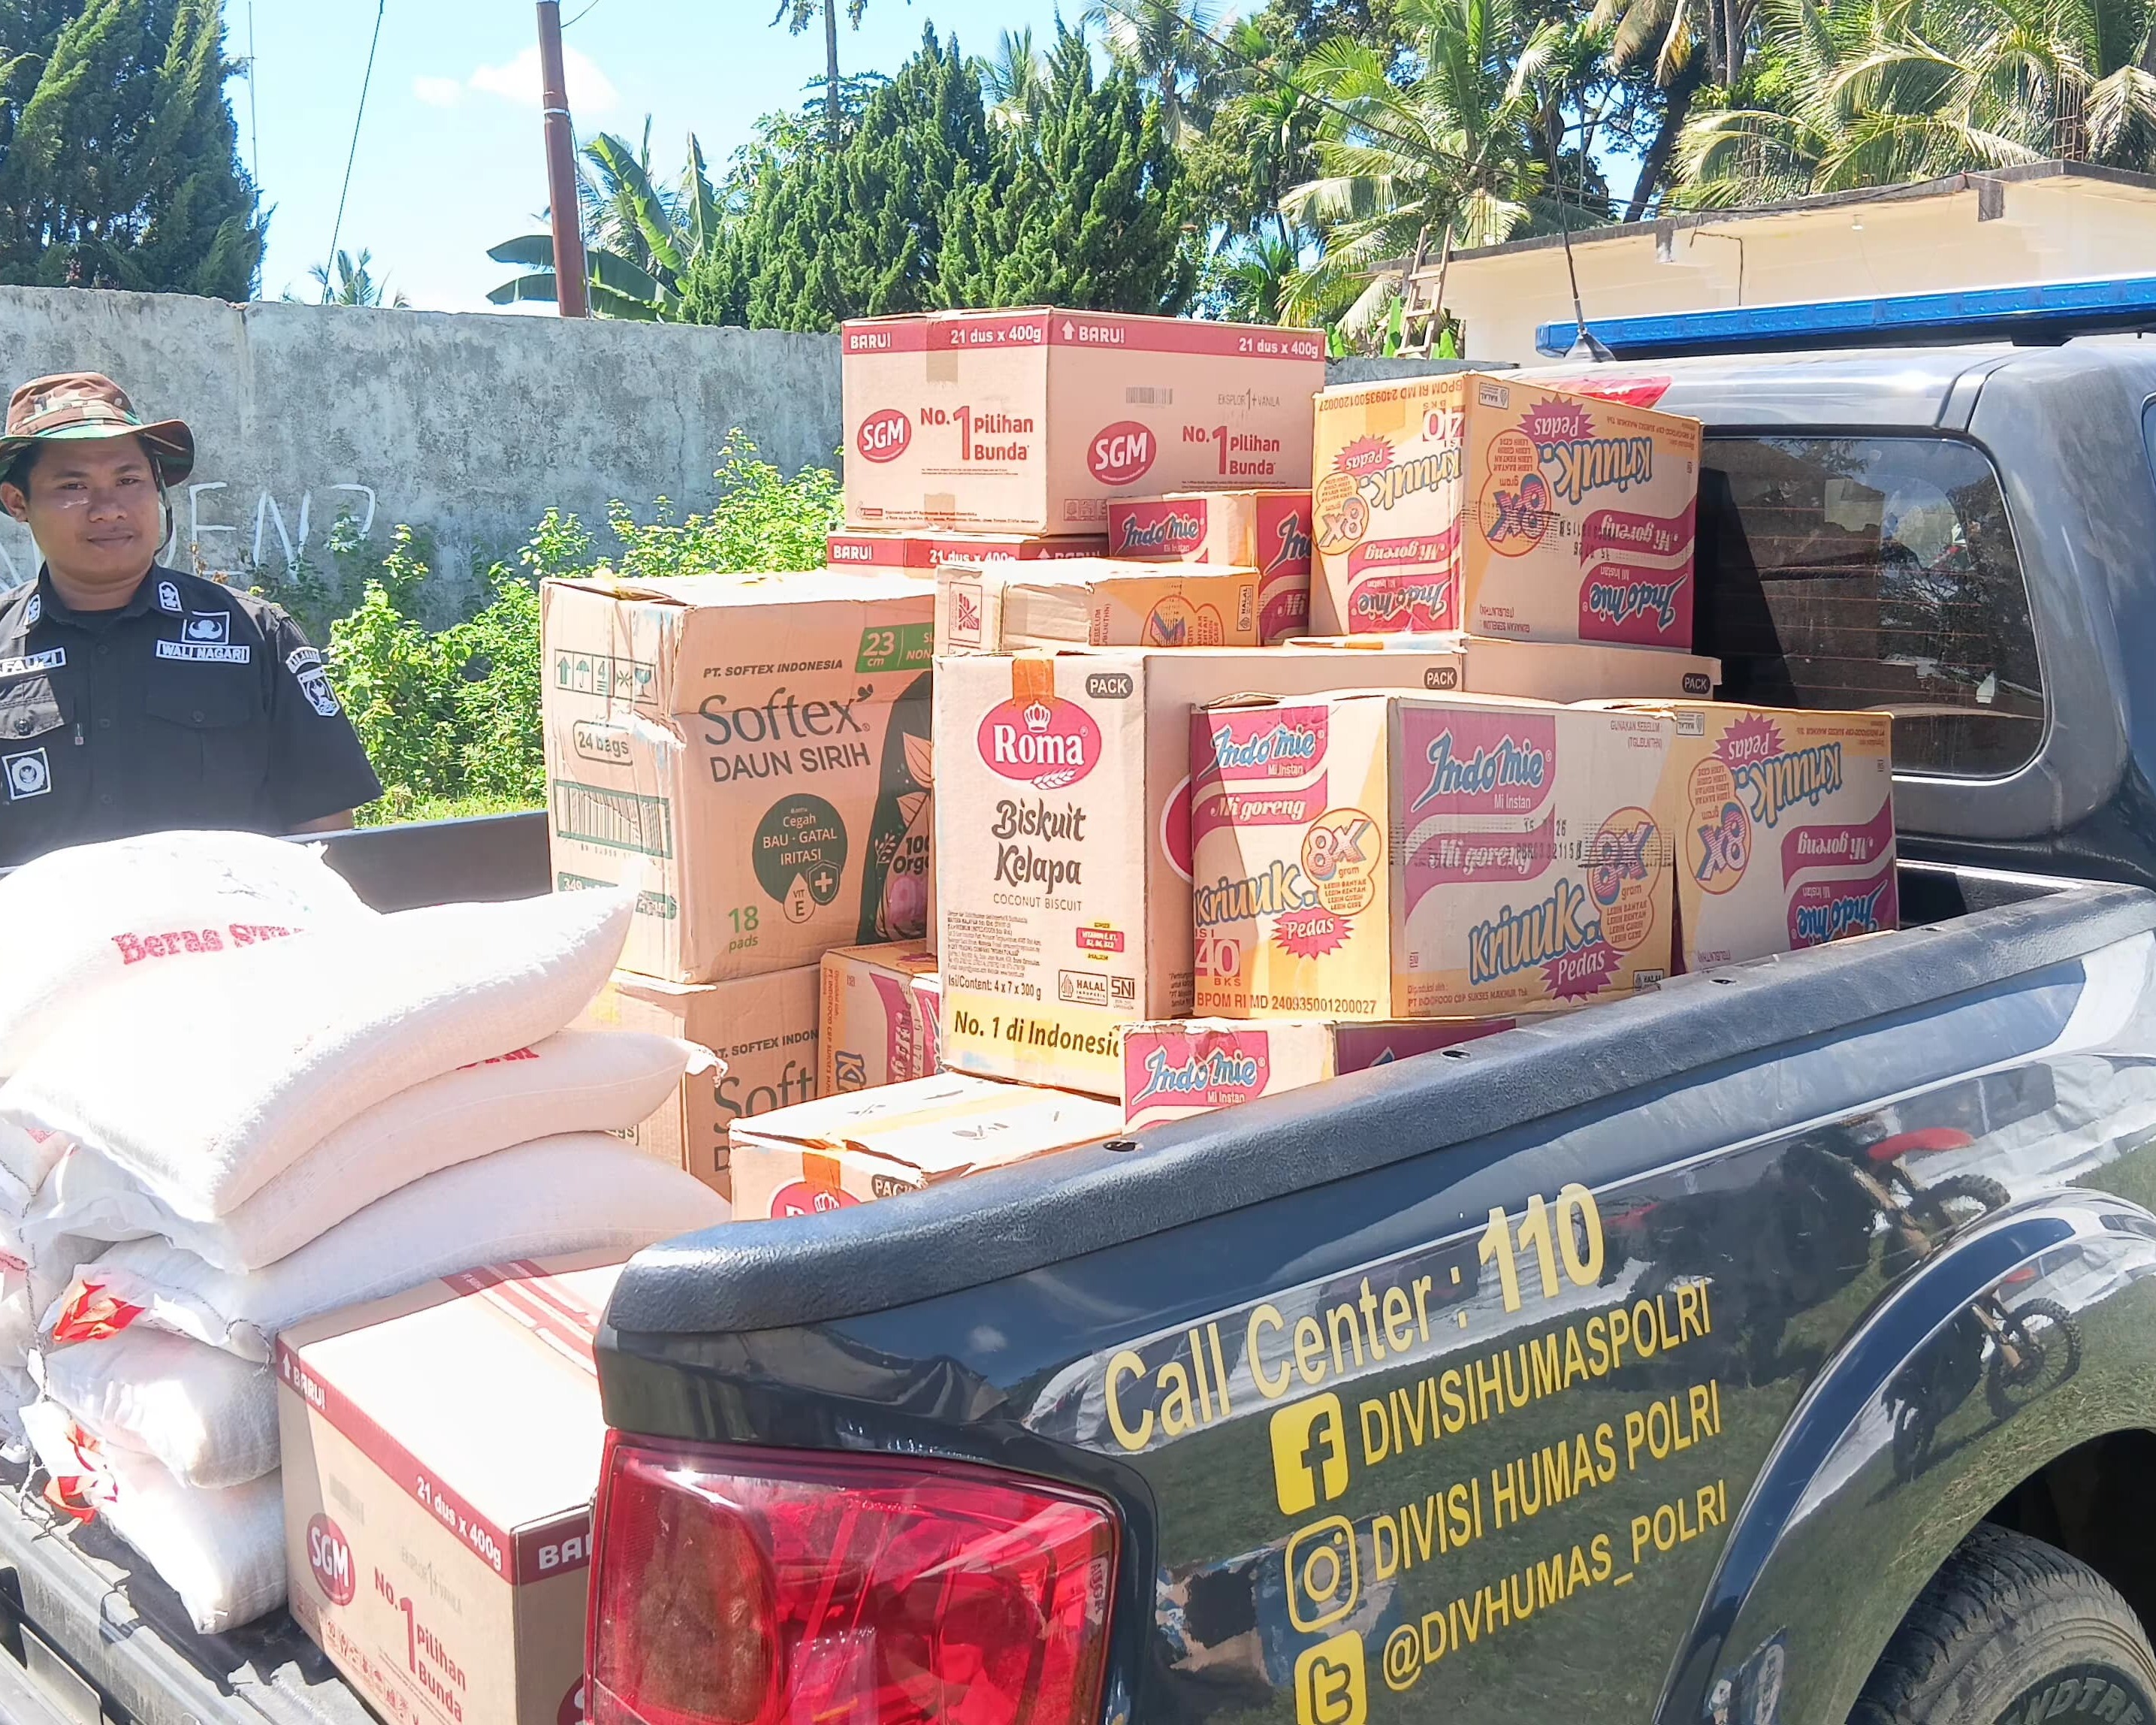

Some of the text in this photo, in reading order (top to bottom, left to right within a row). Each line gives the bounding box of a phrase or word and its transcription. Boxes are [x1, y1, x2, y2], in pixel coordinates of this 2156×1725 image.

[850, 325, 1043, 350] BARU! 21 dus x 400g
[1079, 325, 1320, 359] BARU! 21 dus x 400g
[1400, 386, 1417, 400] MD
[1418, 384, 1429, 396] RI
[1432, 379, 1463, 396] BPOM
[862, 417, 905, 452] SGM
[920, 406, 970, 461] No. 1
[974, 414, 1034, 434] Pilihan
[1423, 405, 1466, 443] 40
[1533, 416, 1580, 438] Pedas
[1095, 432, 1147, 470] SGM
[1182, 425, 1228, 475] No. 1
[1230, 434, 1280, 452] Pilihan
[1345, 448, 1383, 471] Pedas
[1499, 475, 1520, 488] gram
[1599, 515, 1653, 547] goreng
[833, 545, 944, 563] BARU! 21
[1363, 540, 1418, 560] goreng
[1600, 566, 1621, 579] Instan
[162, 643, 247, 660] WALI NAGARI
[862, 631, 895, 658] 23
[703, 659, 844, 678] PT. SOFTEX INDONESIA
[867, 657, 885, 668] cm
[1089, 678, 1129, 694] PACK
[1427, 672, 1455, 687] PACK
[1683, 676, 1708, 691] PACK
[698, 685, 865, 746] Softex
[577, 730, 593, 751] 24
[994, 724, 1086, 766] Roma
[1729, 733, 1769, 762] Pedas
[710, 742, 872, 784] DAUN SIRIH
[1240, 798, 1306, 823] goreng
[1494, 794, 1531, 809] Mi Instan
[783, 814, 817, 829] Cegah
[991, 797, 1087, 843] Biskuit
[762, 830, 838, 849] BAU GATAL
[1797, 831, 1849, 858] goreng
[780, 848, 822, 866] IRITASI
[994, 841, 1083, 895] Kelapa
[1463, 845, 1532, 875] goreng
[1338, 867, 1360, 878] gram
[793, 890, 805, 899] VIT
[993, 893, 1083, 912] COCONUT BISCUIT
[1621, 884, 1642, 901] gram
[728, 905, 759, 934] 18
[796, 901, 805, 917] E
[1285, 915, 1335, 939] Pedas
[728, 934, 759, 955] pads
[1195, 938, 1240, 977] 40
[1557, 950, 1605, 985] Pedas
[948, 974, 1042, 1001] Isi/Content: 4 x 7 x 300 g
[1076, 979, 1107, 992] HALAL
[1111, 976, 1135, 1000] SNI
[1214, 977, 1242, 987] BKS
[1197, 991, 1377, 1014] BPOM RI MD 240935001200027
[954, 1011, 986, 1037] No.
[992, 1017, 1001, 1040] 1
[1007, 1017, 1024, 1044] di
[732, 1029, 819, 1056] SOFTEX INDON
[714, 1059, 817, 1134] Soft
[1218, 1091, 1246, 1104] Instan
[1104, 1183, 1605, 1452] Call Center 110
[1359, 1280, 1713, 1467] DIVISIHUMASPOLRI
[292, 1362, 327, 1410] BARU!
[415, 1475, 431, 1505] 21
[434, 1491, 457, 1525] dus
[469, 1524, 503, 1572] 400g
[1372, 1379, 1722, 1582] DIVISI HUMAS POLRI
[312, 1524, 350, 1588] SGM
[1383, 1480, 1728, 1693] @DIVHUMAS_POLRI
[374, 1566, 416, 1674] No. 1
[416, 1623, 467, 1691] Pilihan
